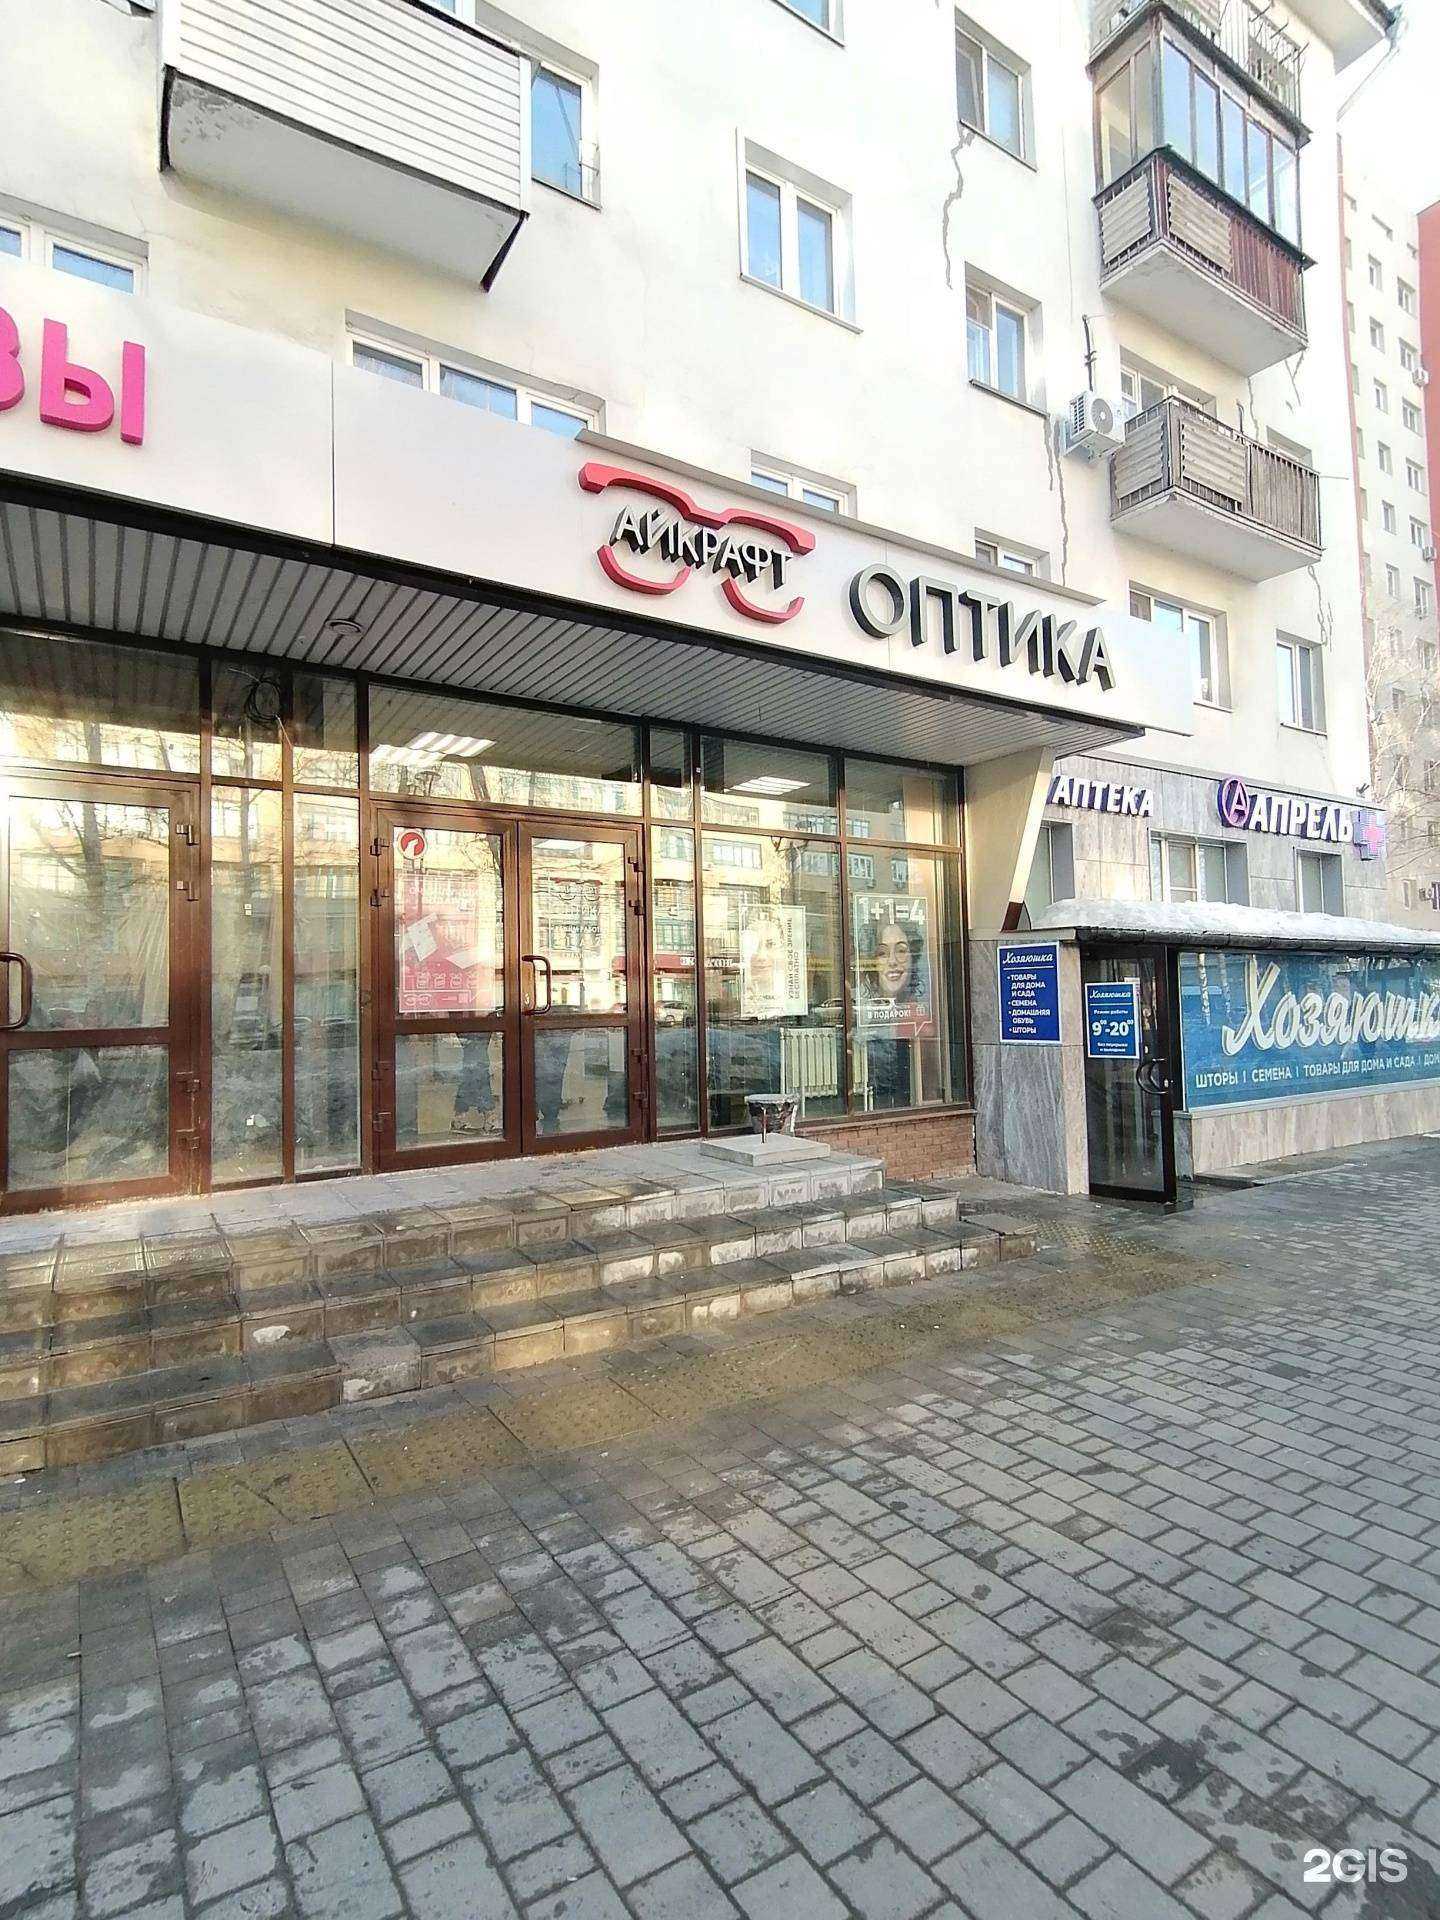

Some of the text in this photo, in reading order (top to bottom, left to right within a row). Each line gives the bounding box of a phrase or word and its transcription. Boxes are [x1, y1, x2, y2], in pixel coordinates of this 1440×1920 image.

[611, 505, 795, 591] АЙКРАФТ
[848, 563, 1115, 692] ОПТИКА
[1051, 775, 1154, 817] АПТЕКА
[1250, 793, 1353, 842] АПРЕЛЬ
[1002, 951, 1053, 965] Хозяюшка
[1011, 981, 1046, 990] ДЛЯ ДОМА
[1195, 1071, 1239, 1088] ШТОРЫ
[1251, 1066, 1293, 1083] СЕМЕНА
[1303, 1062, 1341, 1077] ТОВАРЫ
[1341, 1060, 1359, 1075] ДЛЯ
[1360, 1058, 1384, 1074] ДОМА
[1386, 1057, 1393, 1069] И
[1394, 1055, 1416, 1068] САДА
